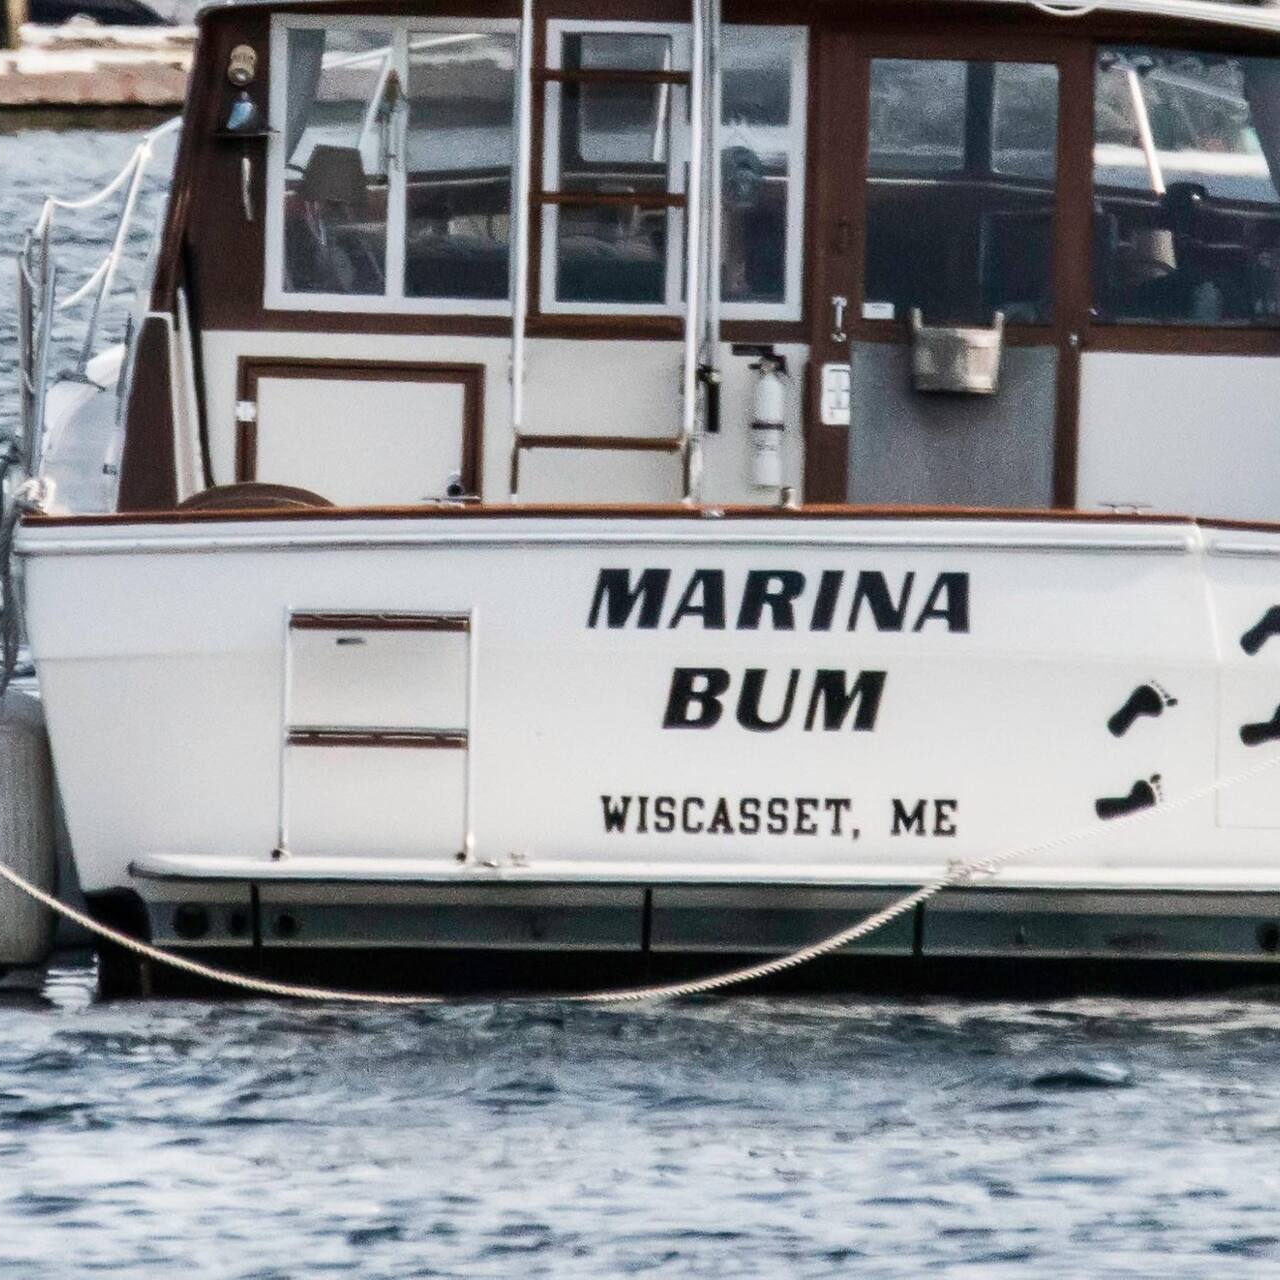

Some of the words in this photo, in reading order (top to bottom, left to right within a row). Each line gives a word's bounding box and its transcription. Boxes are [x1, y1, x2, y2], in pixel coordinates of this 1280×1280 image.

[587, 568, 971, 633] MARINA
[662, 667, 888, 732] BUM
[601, 795, 860, 841] WISCASSET,
[891, 799, 958, 837] ME
